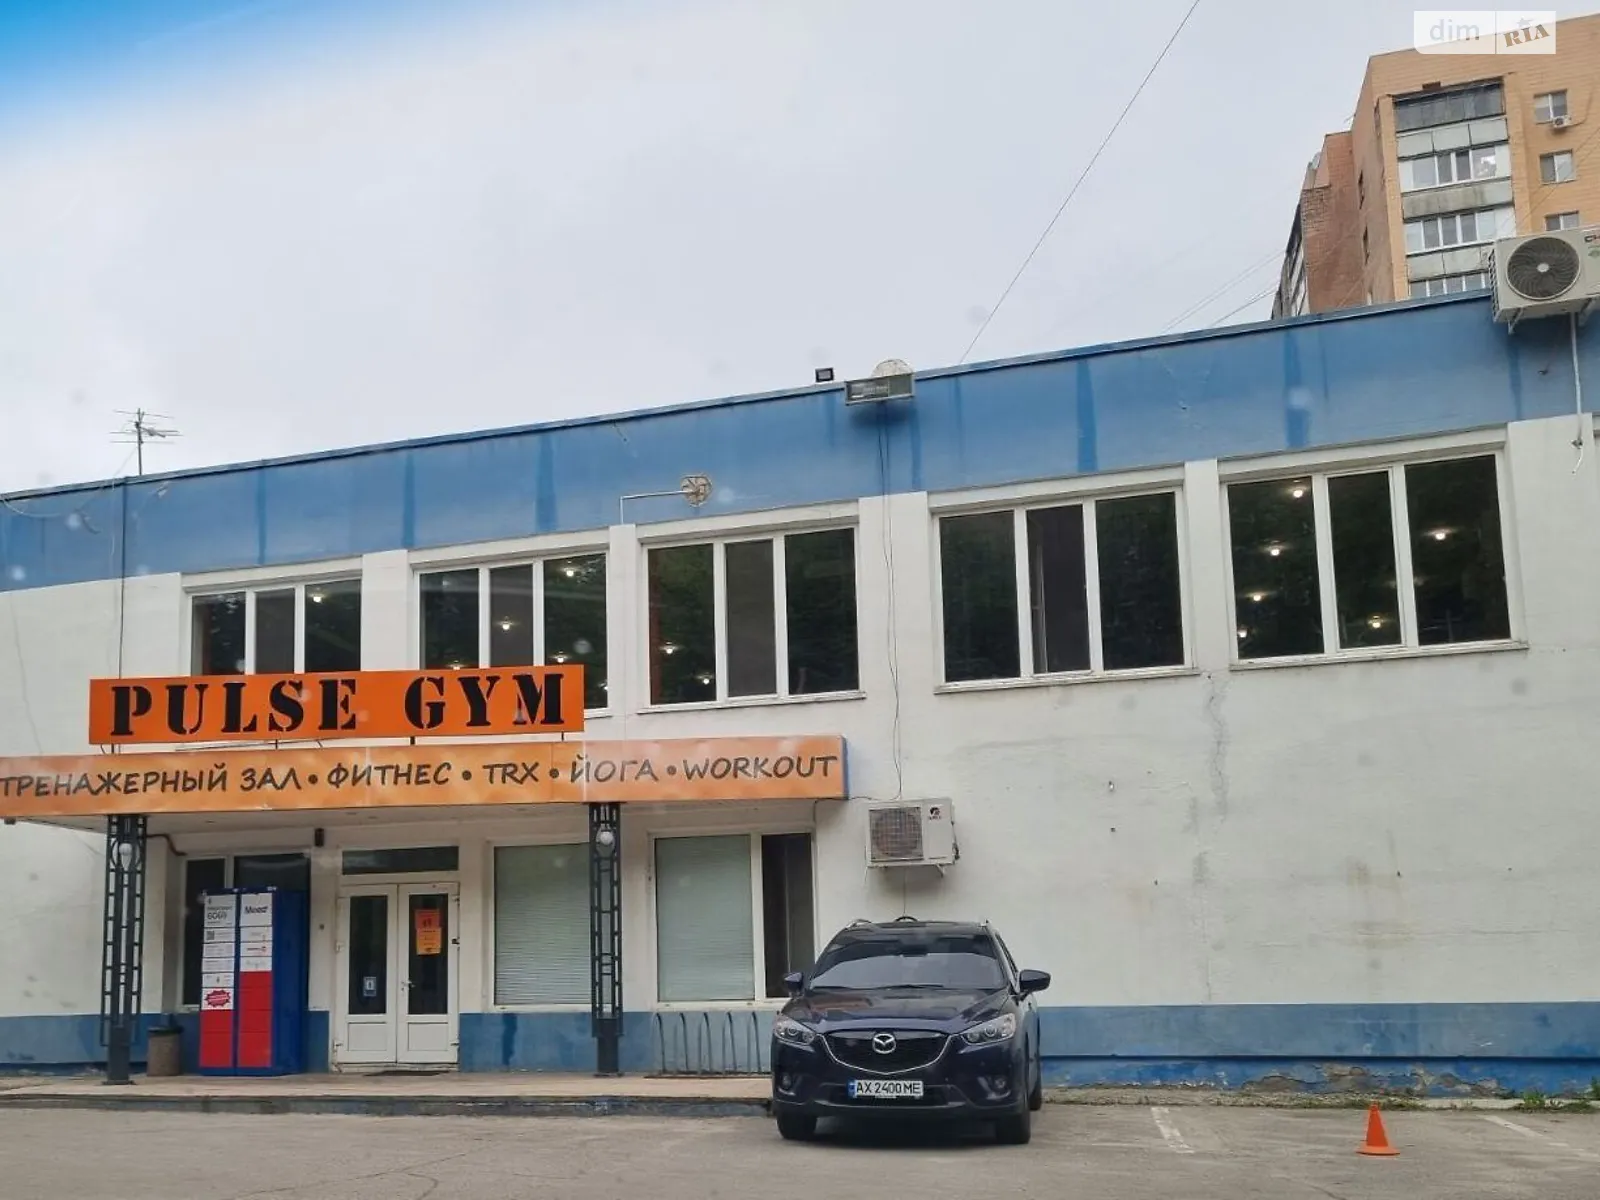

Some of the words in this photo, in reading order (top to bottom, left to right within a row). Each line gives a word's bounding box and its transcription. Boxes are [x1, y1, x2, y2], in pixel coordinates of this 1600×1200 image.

[111, 678, 357, 736] PULSE
[404, 673, 565, 729] GYM
[0, 762, 227, 797] ТРЕНАЖЕРНЫЙ
[240, 767, 302, 792] ЗАЛ
[327, 761, 452, 789] ФИТНЕС
[482, 761, 539, 785] TRX
[570, 754, 659, 783] ЙОГА
[682, 755, 838, 782] WORKOUT
[857, 1082, 872, 1094] AX
[875, 1082, 902, 1094] 2400
[904, 1081, 921, 1094] ME
